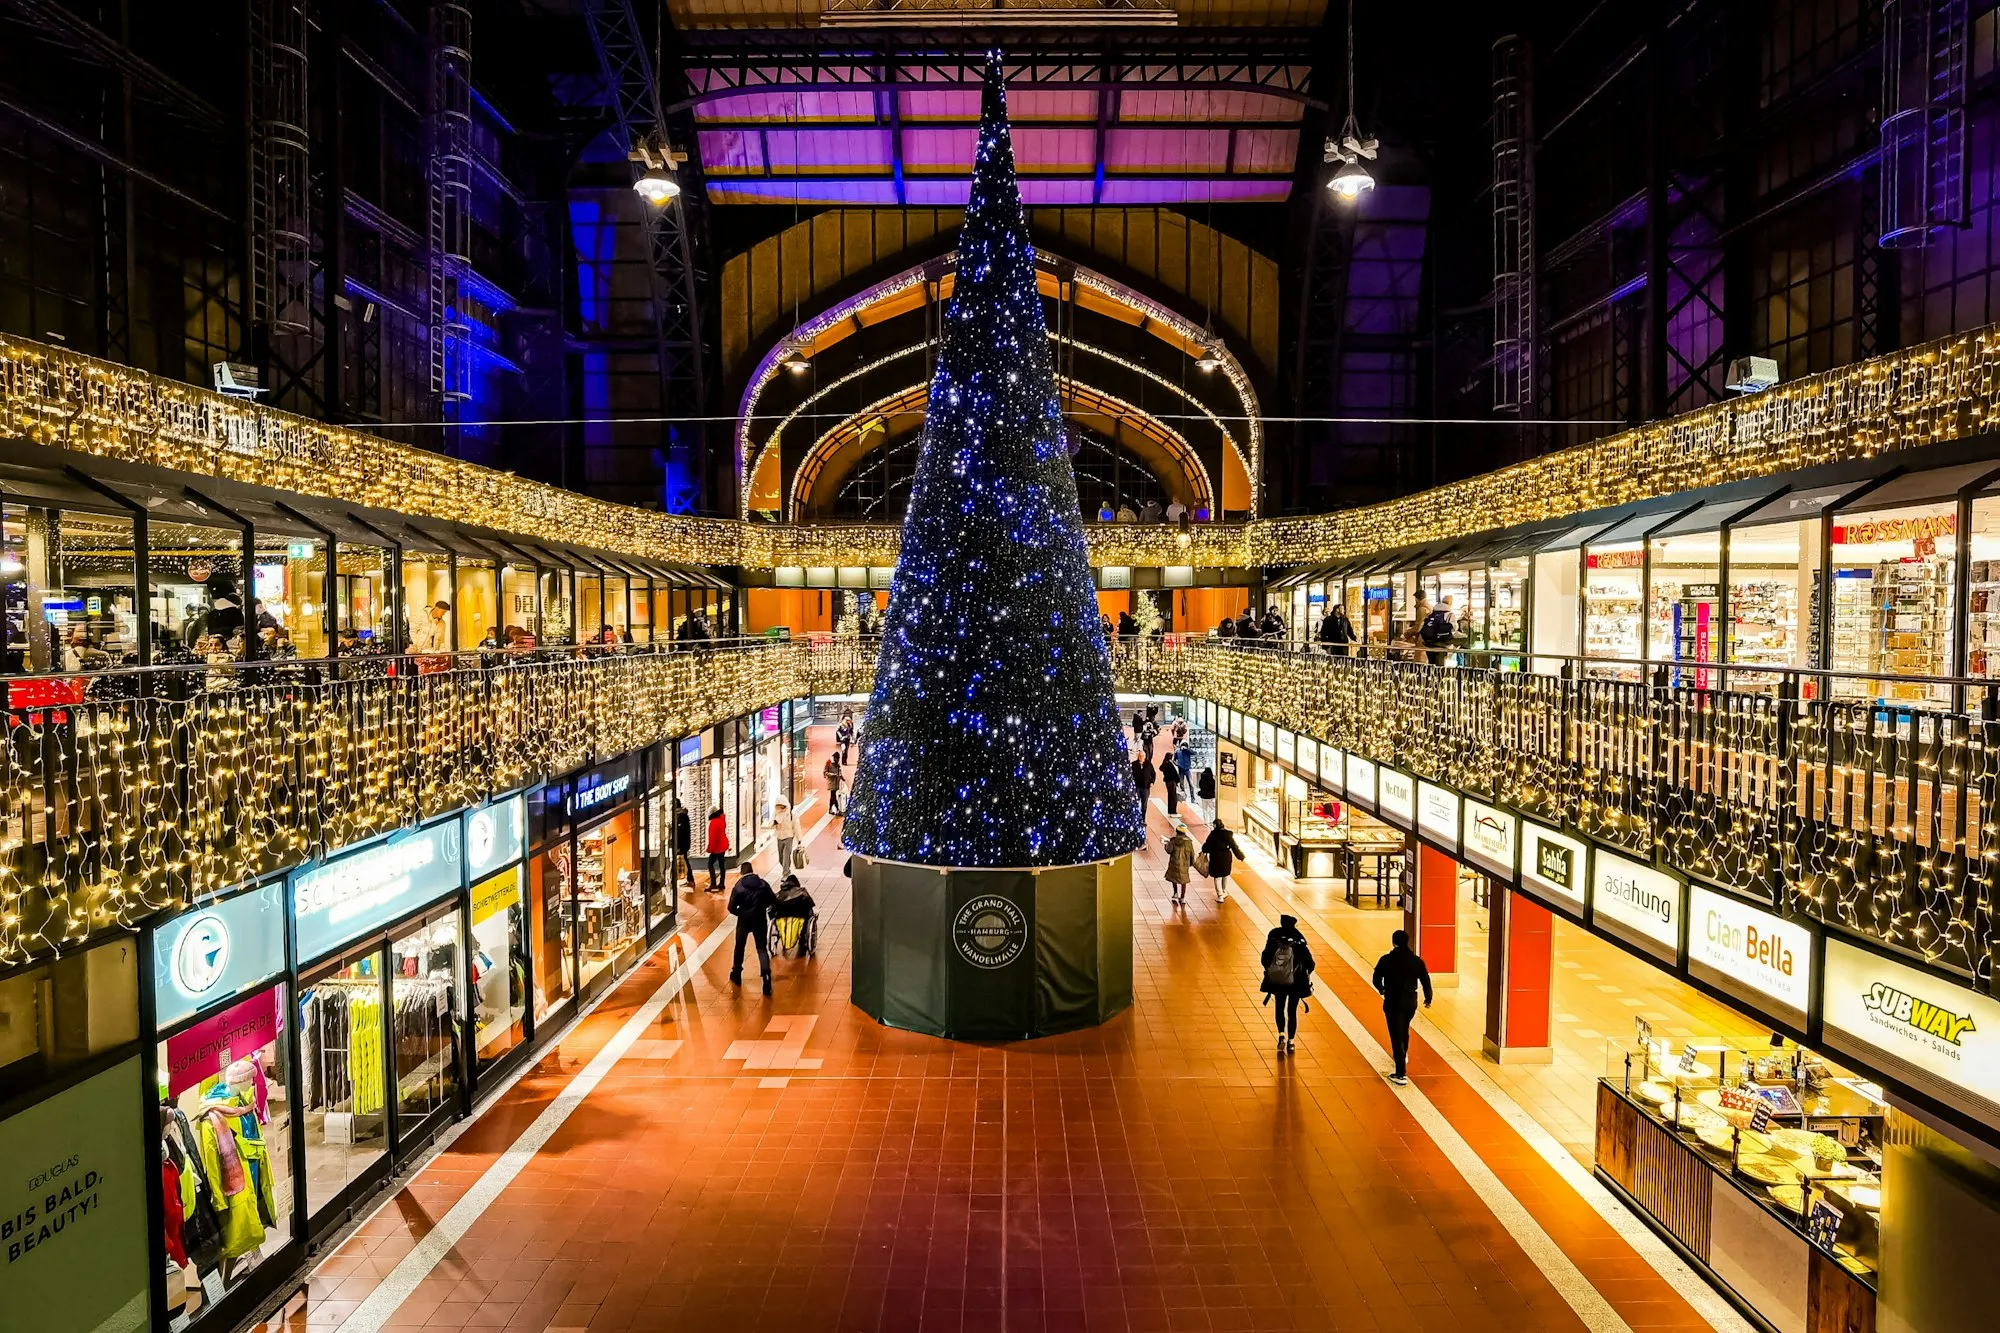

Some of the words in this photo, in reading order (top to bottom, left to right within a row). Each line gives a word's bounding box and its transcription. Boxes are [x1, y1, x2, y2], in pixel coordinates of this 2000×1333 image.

[580, 788, 595, 808] THE
[595, 782, 613, 802] BODY
[612, 775, 630, 795] SHOP
[1542, 846, 1567, 876] Sahha
[959, 908, 973, 925] THE
[971, 899, 1004, 911] GRAND
[1003, 904, 1020, 926] HALL
[1605, 875, 1671, 923] asiahung
[970, 928, 1010, 936] HAMBURG
[1746, 925, 1792, 976] Bella
[1862, 982, 1976, 1047] SUBWAY
[1869, 1012, 1918, 1041] Sandwiches
[1932, 1040, 1961, 1061] Salads
[172, 1012, 273, 1074] SCHIETWETTER.DE
[28, 1153, 79, 1191] DOUGLAS
[1, 1206, 36, 1240] BIS
[45, 1171, 103, 1214] BALD,
[8, 1192, 98, 1264] BEAUTY!
